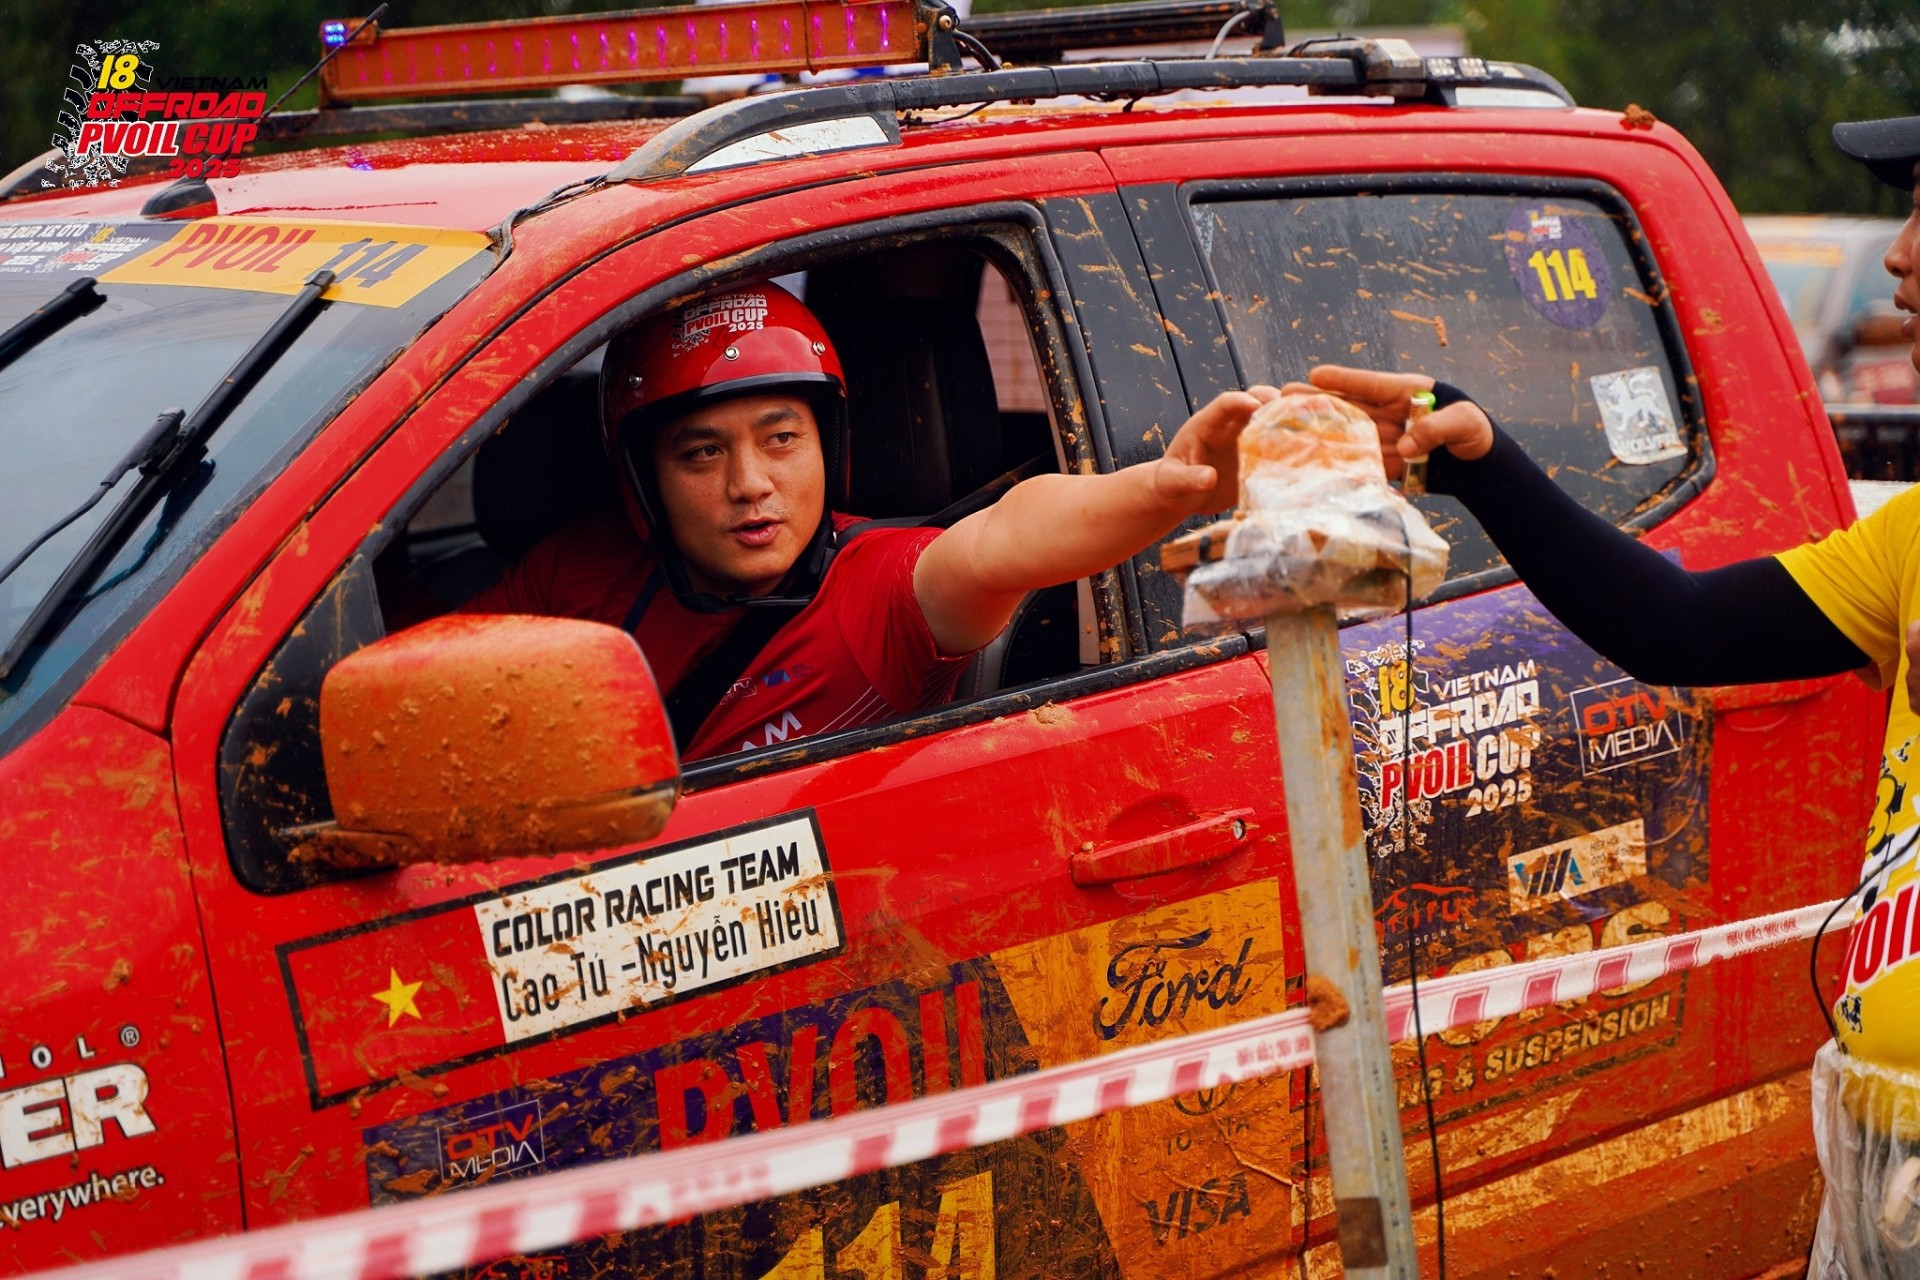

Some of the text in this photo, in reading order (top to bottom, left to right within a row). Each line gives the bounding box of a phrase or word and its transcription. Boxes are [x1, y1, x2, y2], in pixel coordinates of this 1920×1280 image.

[150, 224, 429, 288] PVOIL 114
[1528, 248, 1597, 301] 114
[684, 299, 767, 320] OFFROAD
[684, 308, 768, 339] PVOIL CUP
[729, 321, 764, 333] 2025
[1378, 659, 1538, 715] 18 VIETNAM
[1583, 691, 1668, 736] OTV
[1380, 680, 1541, 756] OFFROAD
[1588, 720, 1677, 764] MEDIA
[1381, 725, 1541, 810] PVOIL CUP
[1465, 778, 1533, 818] 2025
[493, 842, 799, 957] COLOR RACING TEAM
[502, 972, 560, 1022] Cao
[571, 950, 608, 1002] Tú
[1092, 928, 1253, 1040] Ford
[1483, 994, 1670, 1082] SUSPENSION
[447, 1114, 534, 1160] OTV
[450, 1141, 540, 1179] MEDIA
[0, 1166, 164, 1228] verywhere.
[1146, 1171, 1251, 1246] VISA
